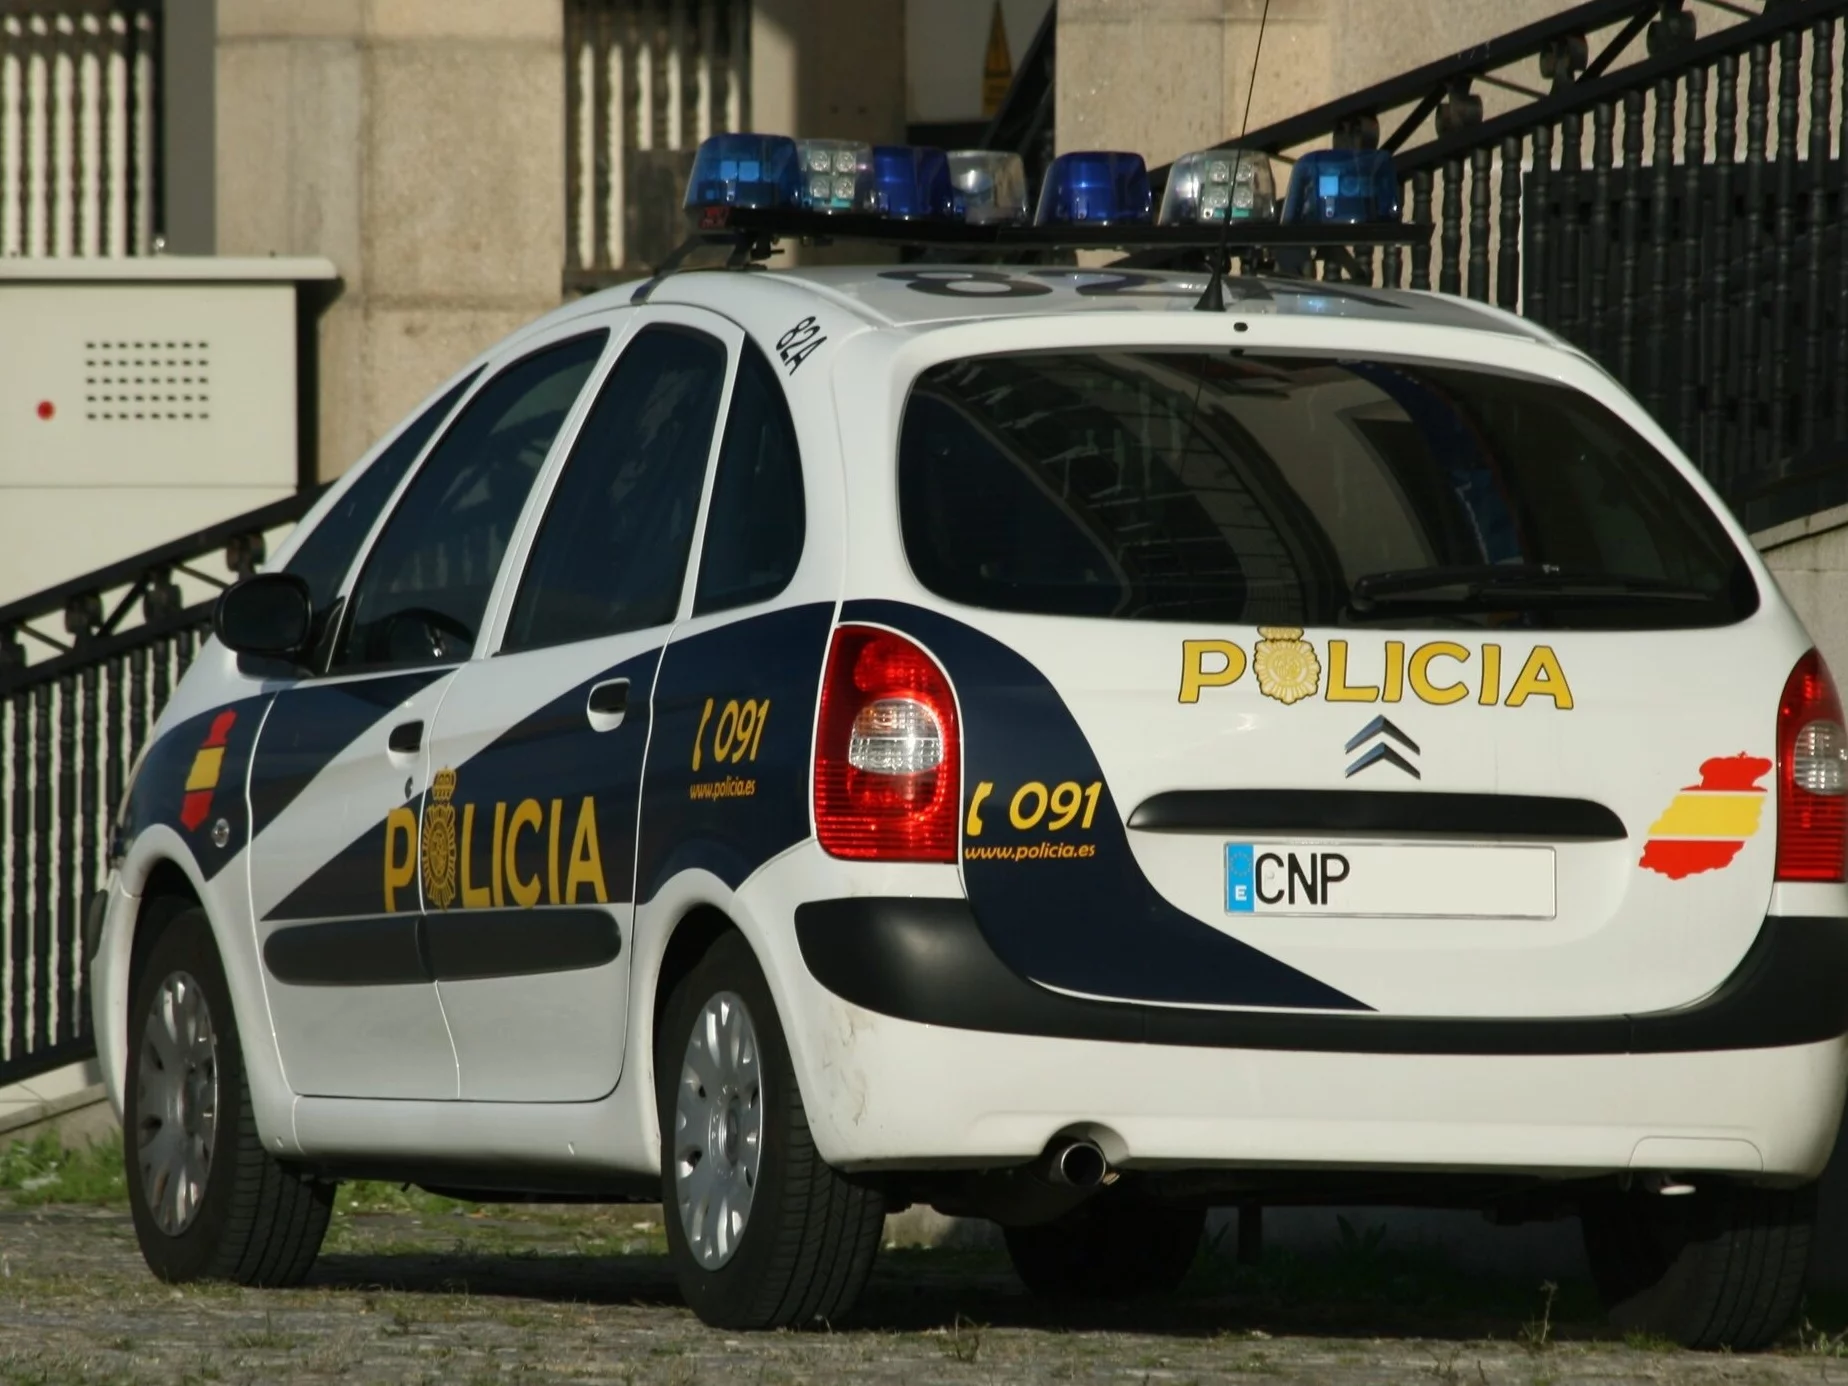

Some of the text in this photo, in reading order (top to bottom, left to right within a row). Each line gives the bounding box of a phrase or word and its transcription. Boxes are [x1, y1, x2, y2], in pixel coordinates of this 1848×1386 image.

[776, 316, 827, 376] 82A
[714, 699, 770, 764] 091
[690, 775, 756, 802] www.policia.es
[1009, 781, 1102, 831] 091
[964, 841, 1096, 861] www.policia.es
[1235, 885, 1247, 901] E
[1255, 852, 1350, 906] CNP
